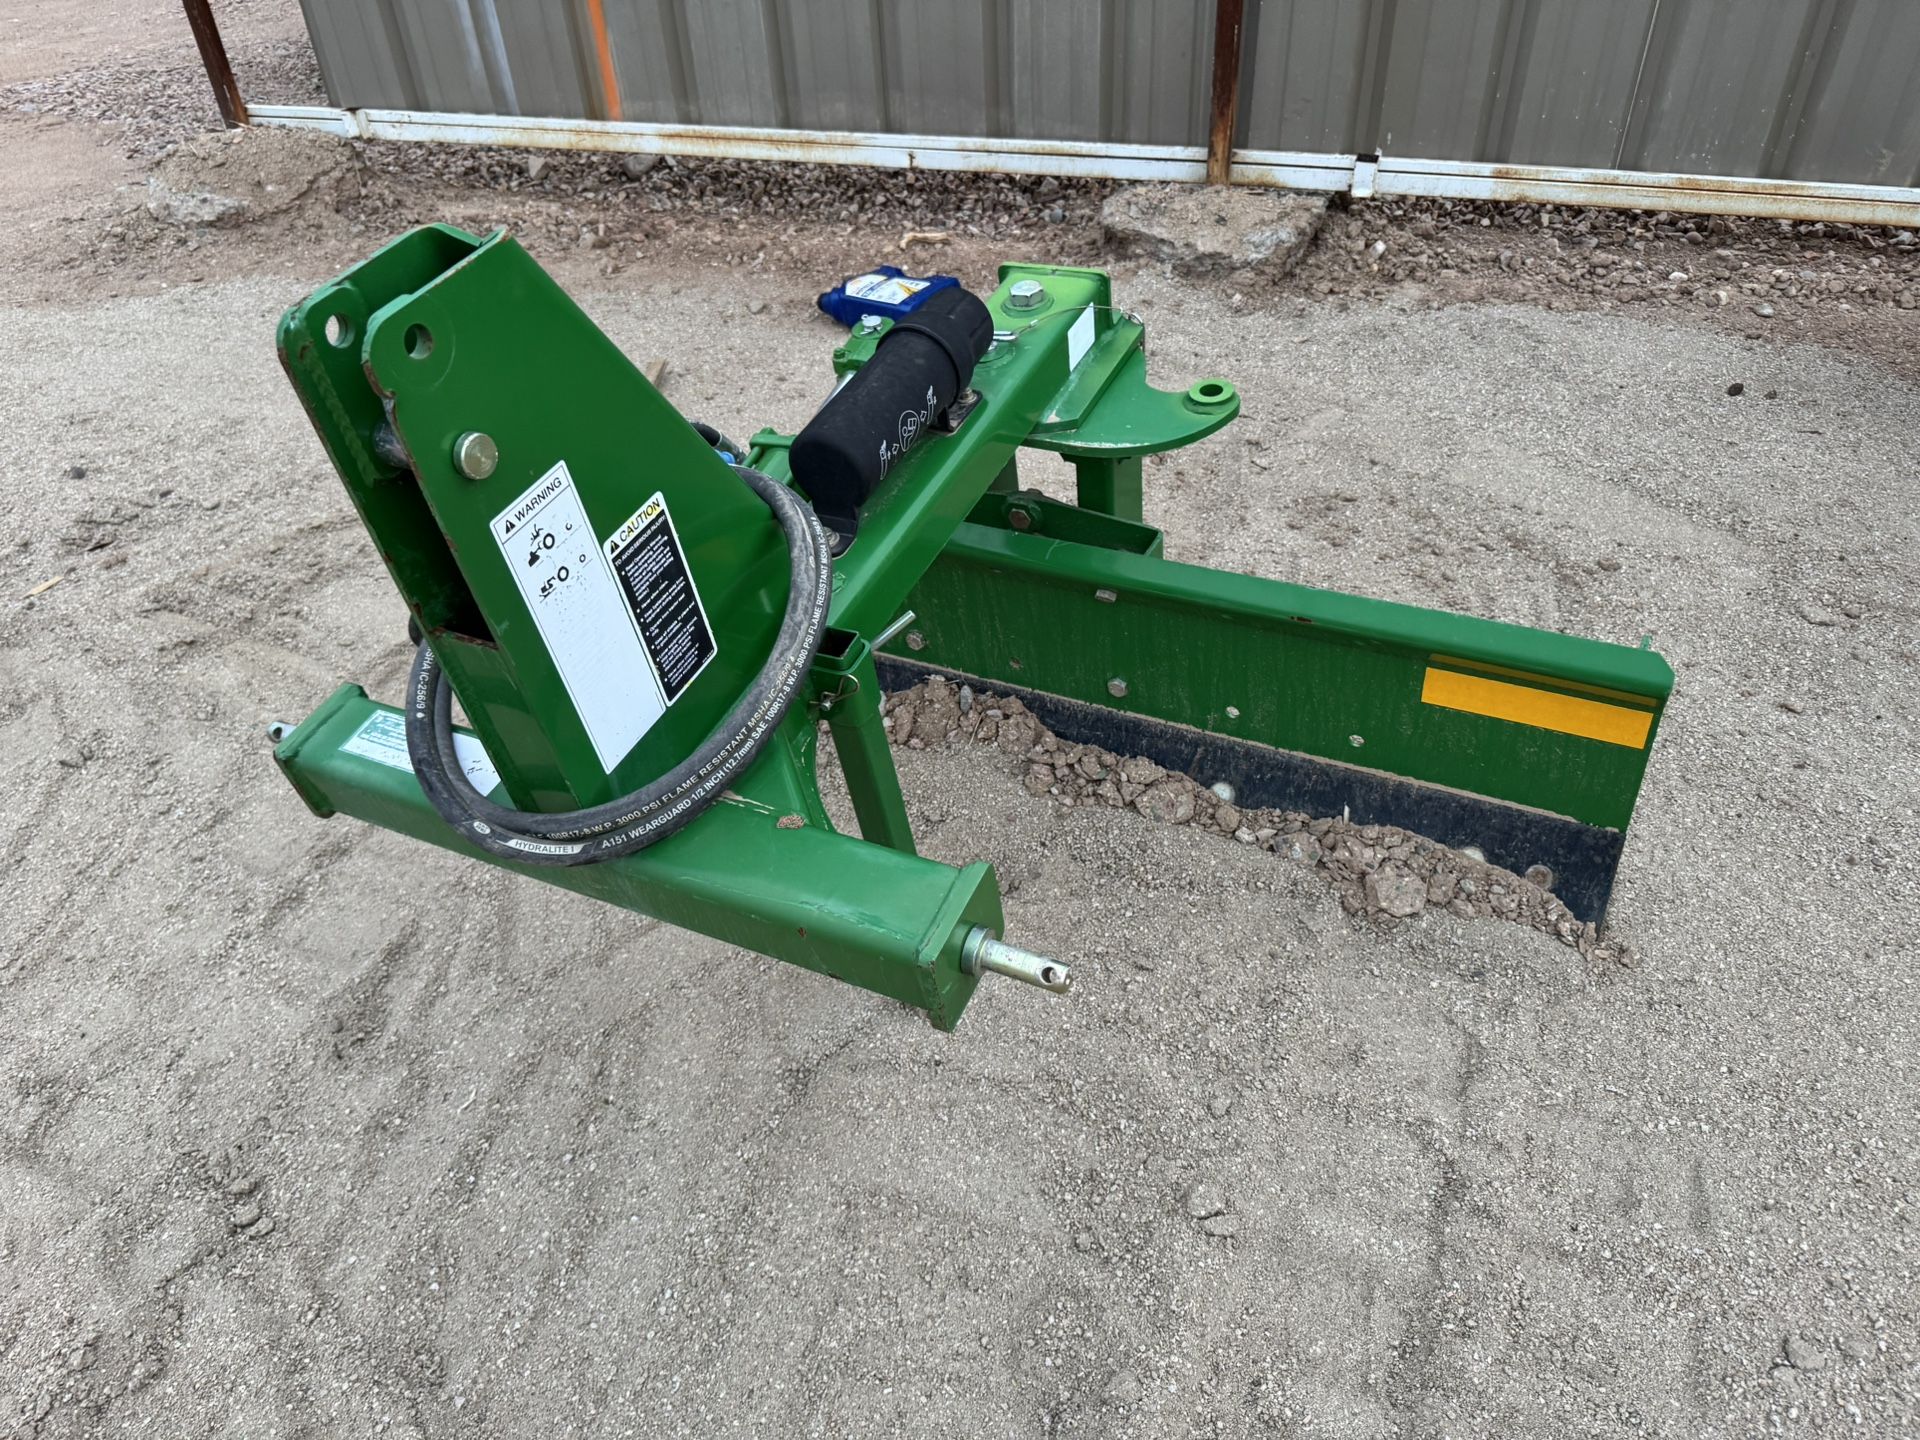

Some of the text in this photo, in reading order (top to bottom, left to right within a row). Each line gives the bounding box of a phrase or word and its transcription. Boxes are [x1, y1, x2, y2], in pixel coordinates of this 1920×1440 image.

[514, 477, 562, 522] WARNING
[619, 498, 660, 542] CAUTION
[815, 565, 829, 607] RESISTANT
[807, 606, 822, 635] FLAME
[802, 634, 814, 649] PSI
[795, 649, 808, 669] 3000
[785, 668, 800, 686] W.P.
[765, 685, 791, 721] 100R17-8
[751, 720, 768, 740] SAE
[591, 821, 616, 833] W.P.
[616, 810, 641, 825] 3000
[642, 800, 661, 814] PSI
[661, 774, 699, 803] FLAME
[699, 727, 749, 777] RESISTANT
[747, 700, 771, 728] MSHA
[722, 738, 755, 773] (12.7mm)
[703, 770, 725, 791] INCH
[691, 788, 706, 801] 1/2
[628, 799, 692, 840] WEARGUARD
[515, 840, 569, 854] HYDRALITE
[602, 834, 627, 849] A151
